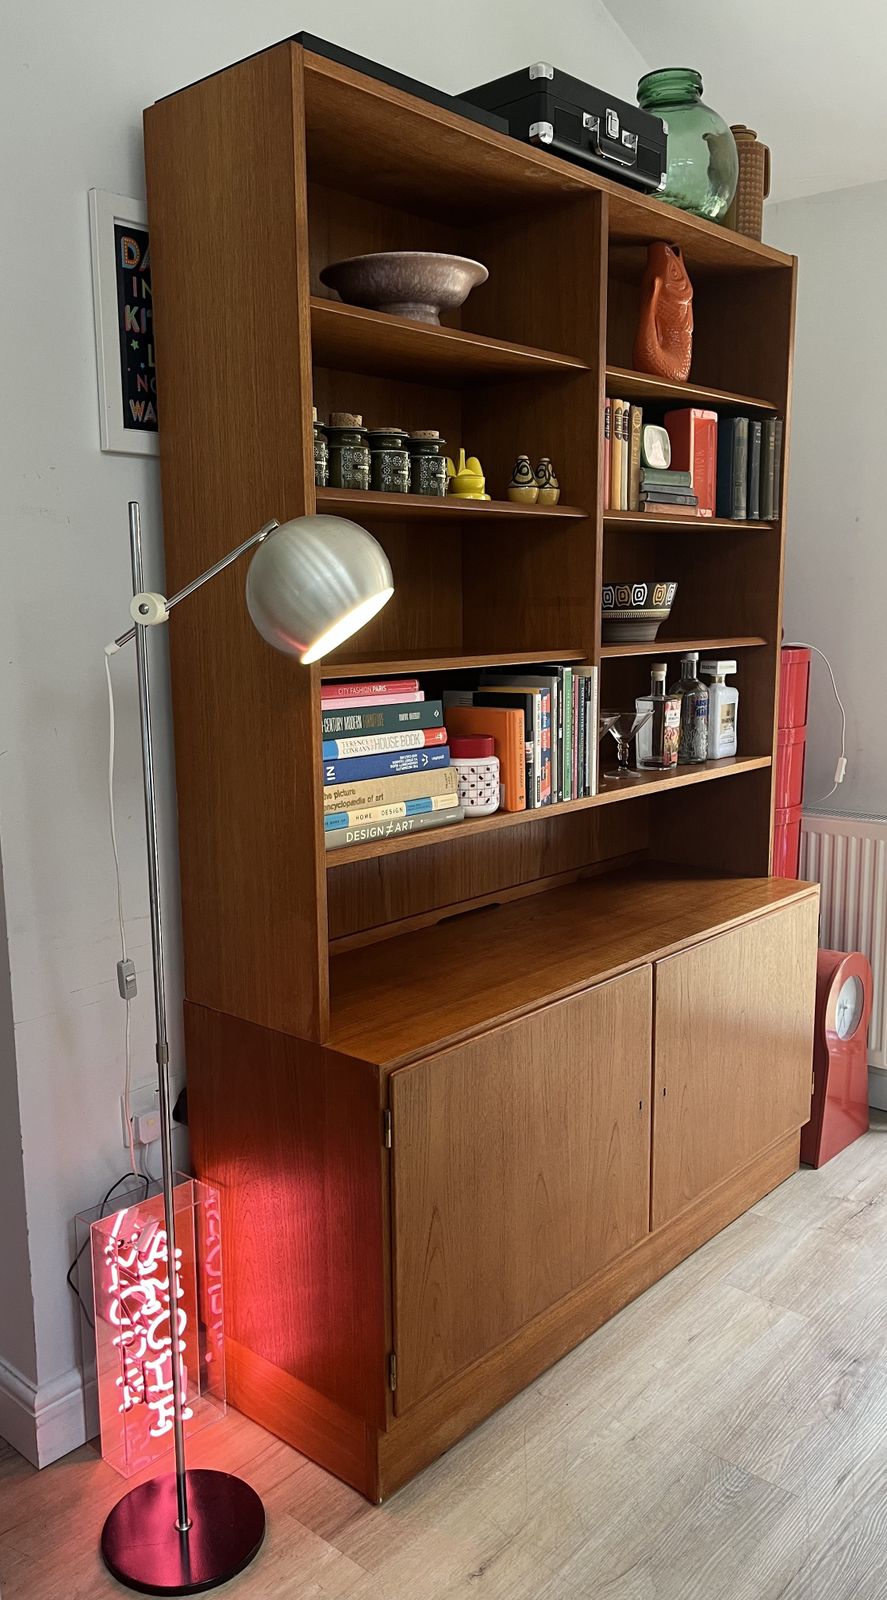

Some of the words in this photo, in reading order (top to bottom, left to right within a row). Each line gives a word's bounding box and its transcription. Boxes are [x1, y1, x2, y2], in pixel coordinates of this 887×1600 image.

[350, 686, 372, 694] FASHION
[344, 715, 363, 731] MODERN
[375, 735, 400, 751] HOUSE
[400, 733, 421, 747] BOOK
[334, 789, 356, 800] picture
[375, 793, 384, 801] art
[355, 813, 373, 821] HOME
[381, 807, 404, 816] DESIGN
